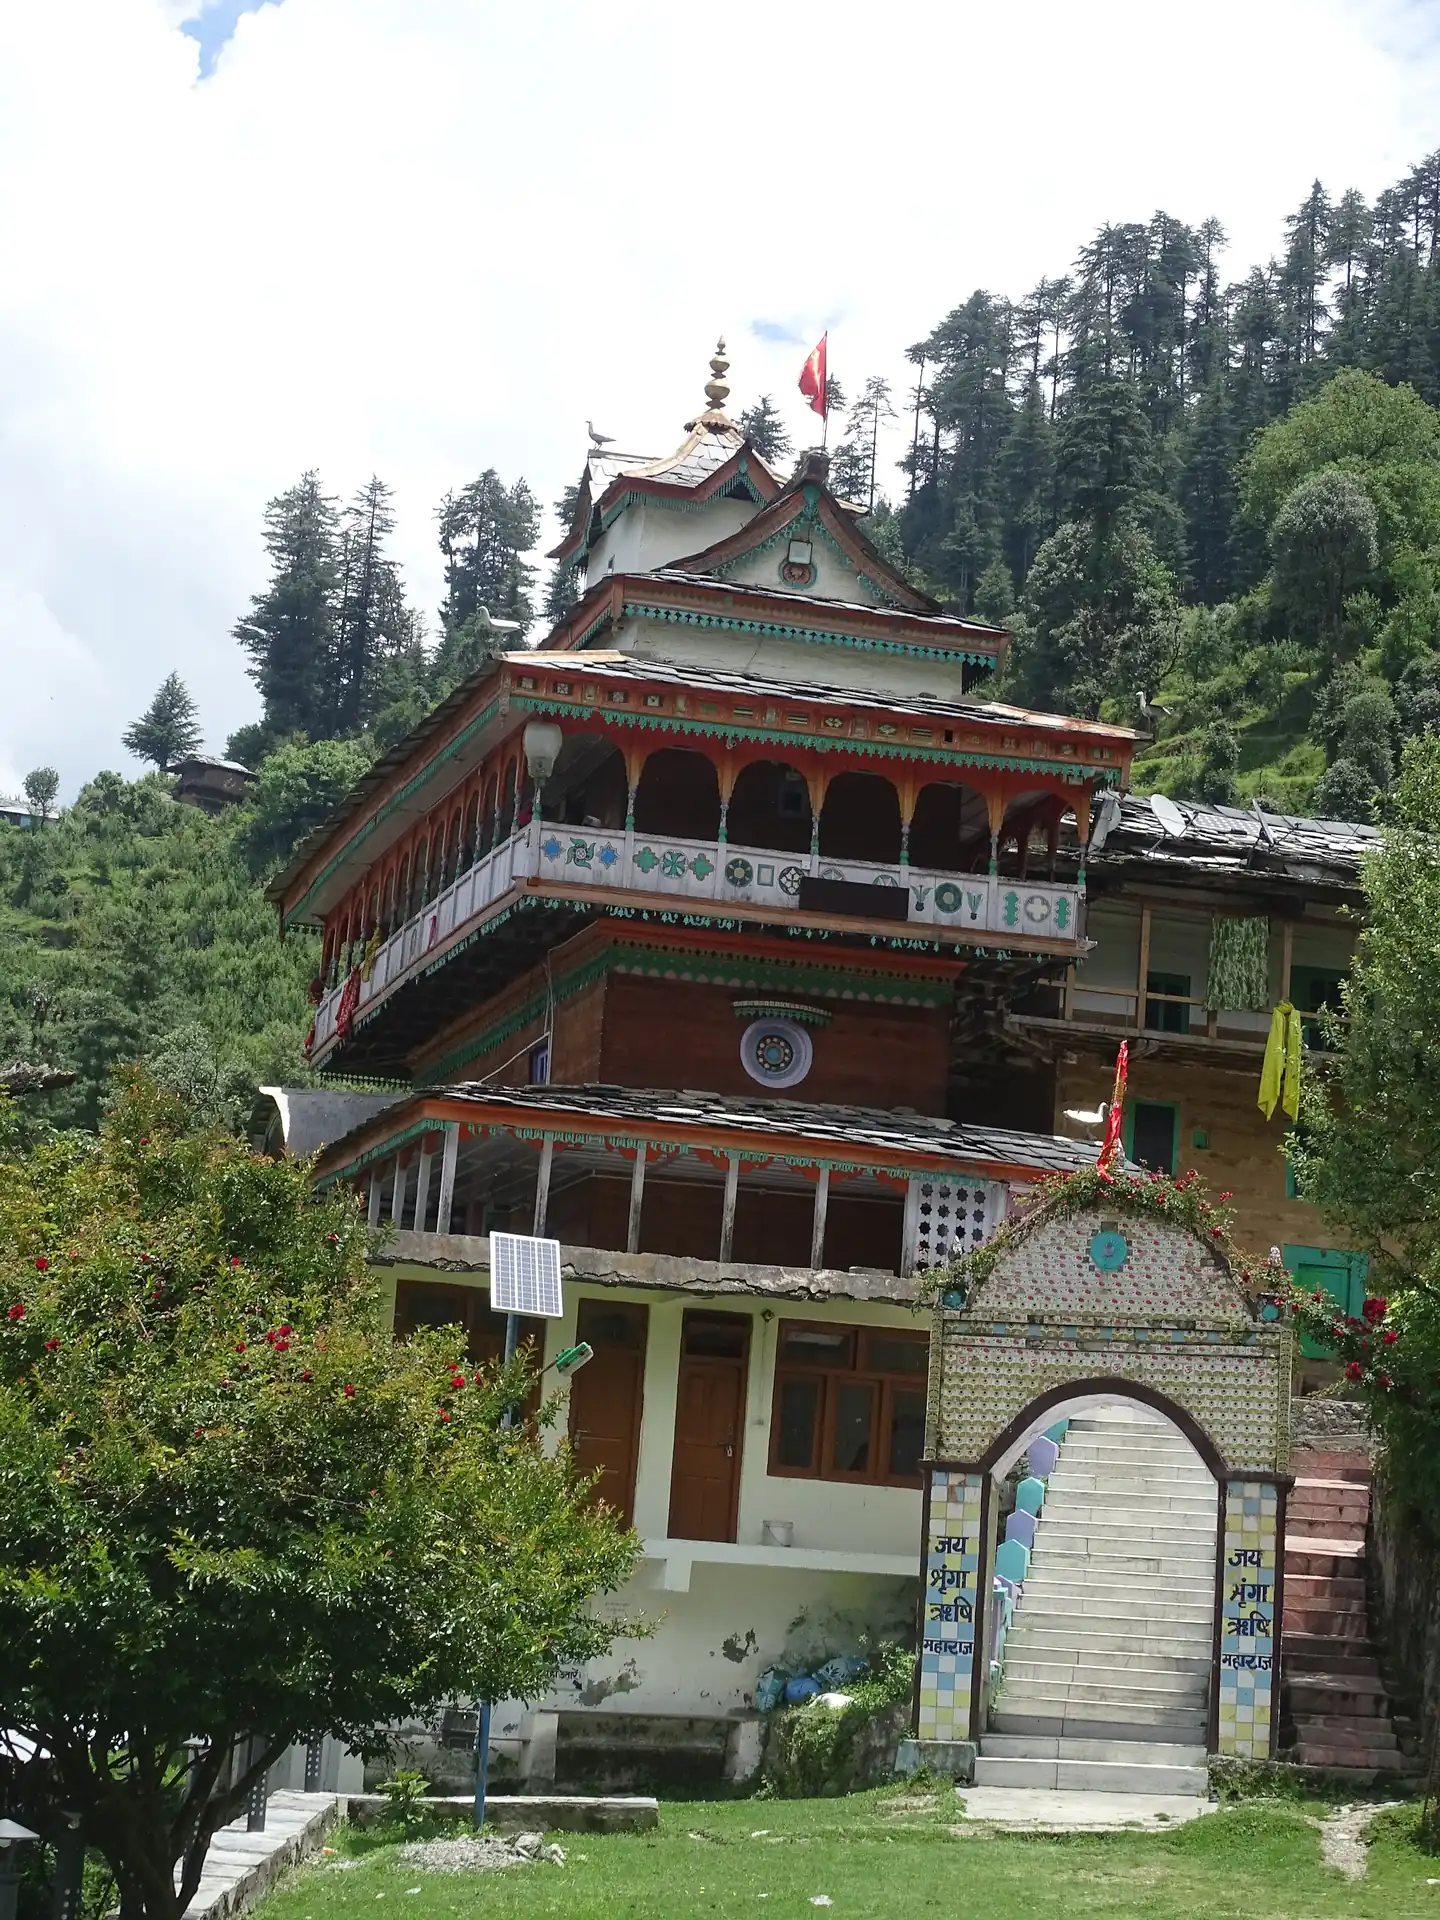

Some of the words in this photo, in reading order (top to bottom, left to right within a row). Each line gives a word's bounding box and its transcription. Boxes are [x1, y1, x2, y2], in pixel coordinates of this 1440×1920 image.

[935, 1536, 969, 1554] जय
[1228, 1549, 1263, 1567] जय
[929, 1596, 972, 1622] ऋषि
[1228, 1611, 1271, 1637] ऋषि
[924, 1639, 974, 1655] महाराज
[1222, 1654, 1272, 1670] महाराज
